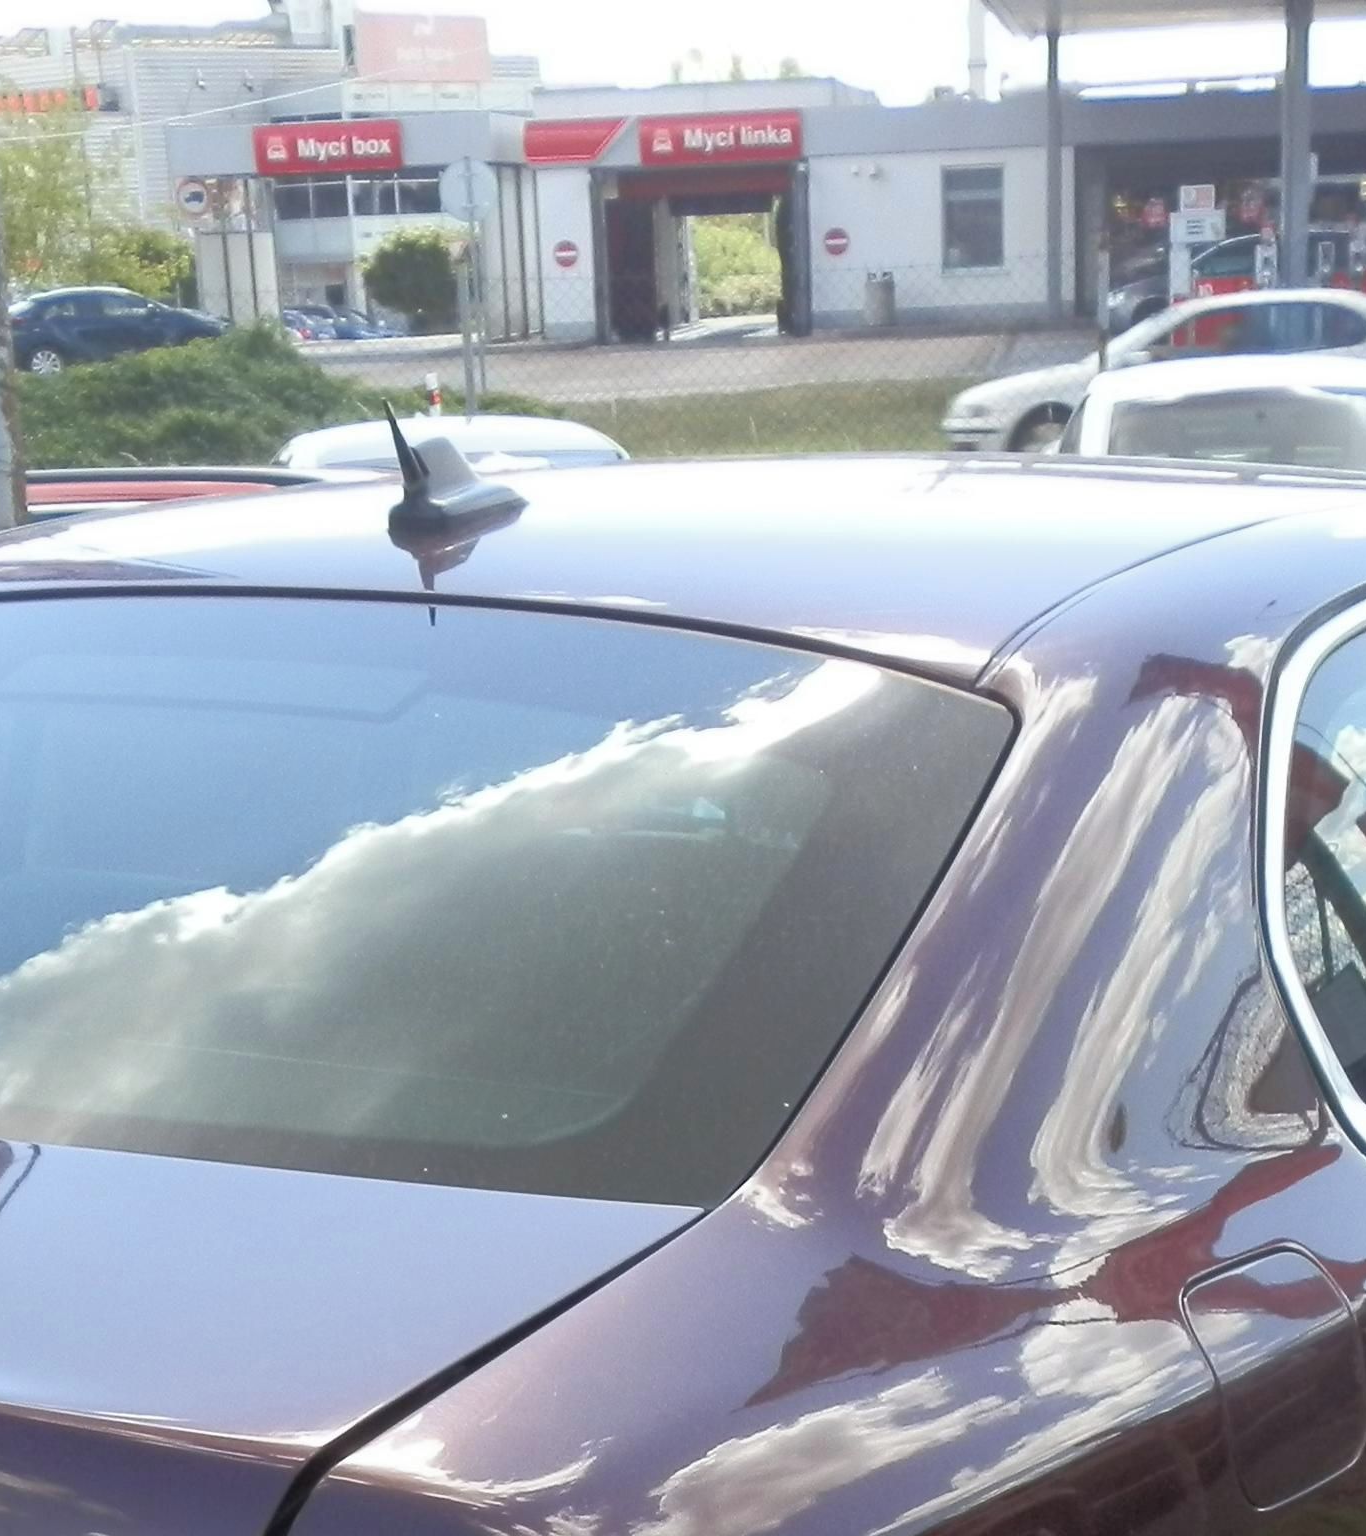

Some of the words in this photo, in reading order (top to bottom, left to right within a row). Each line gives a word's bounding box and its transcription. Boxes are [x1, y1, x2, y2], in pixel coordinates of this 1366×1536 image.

[297, 136, 347, 161] Mycí
[351, 136, 392, 156] box
[684, 126, 734, 152] Mycí
[740, 125, 793, 146] linka
